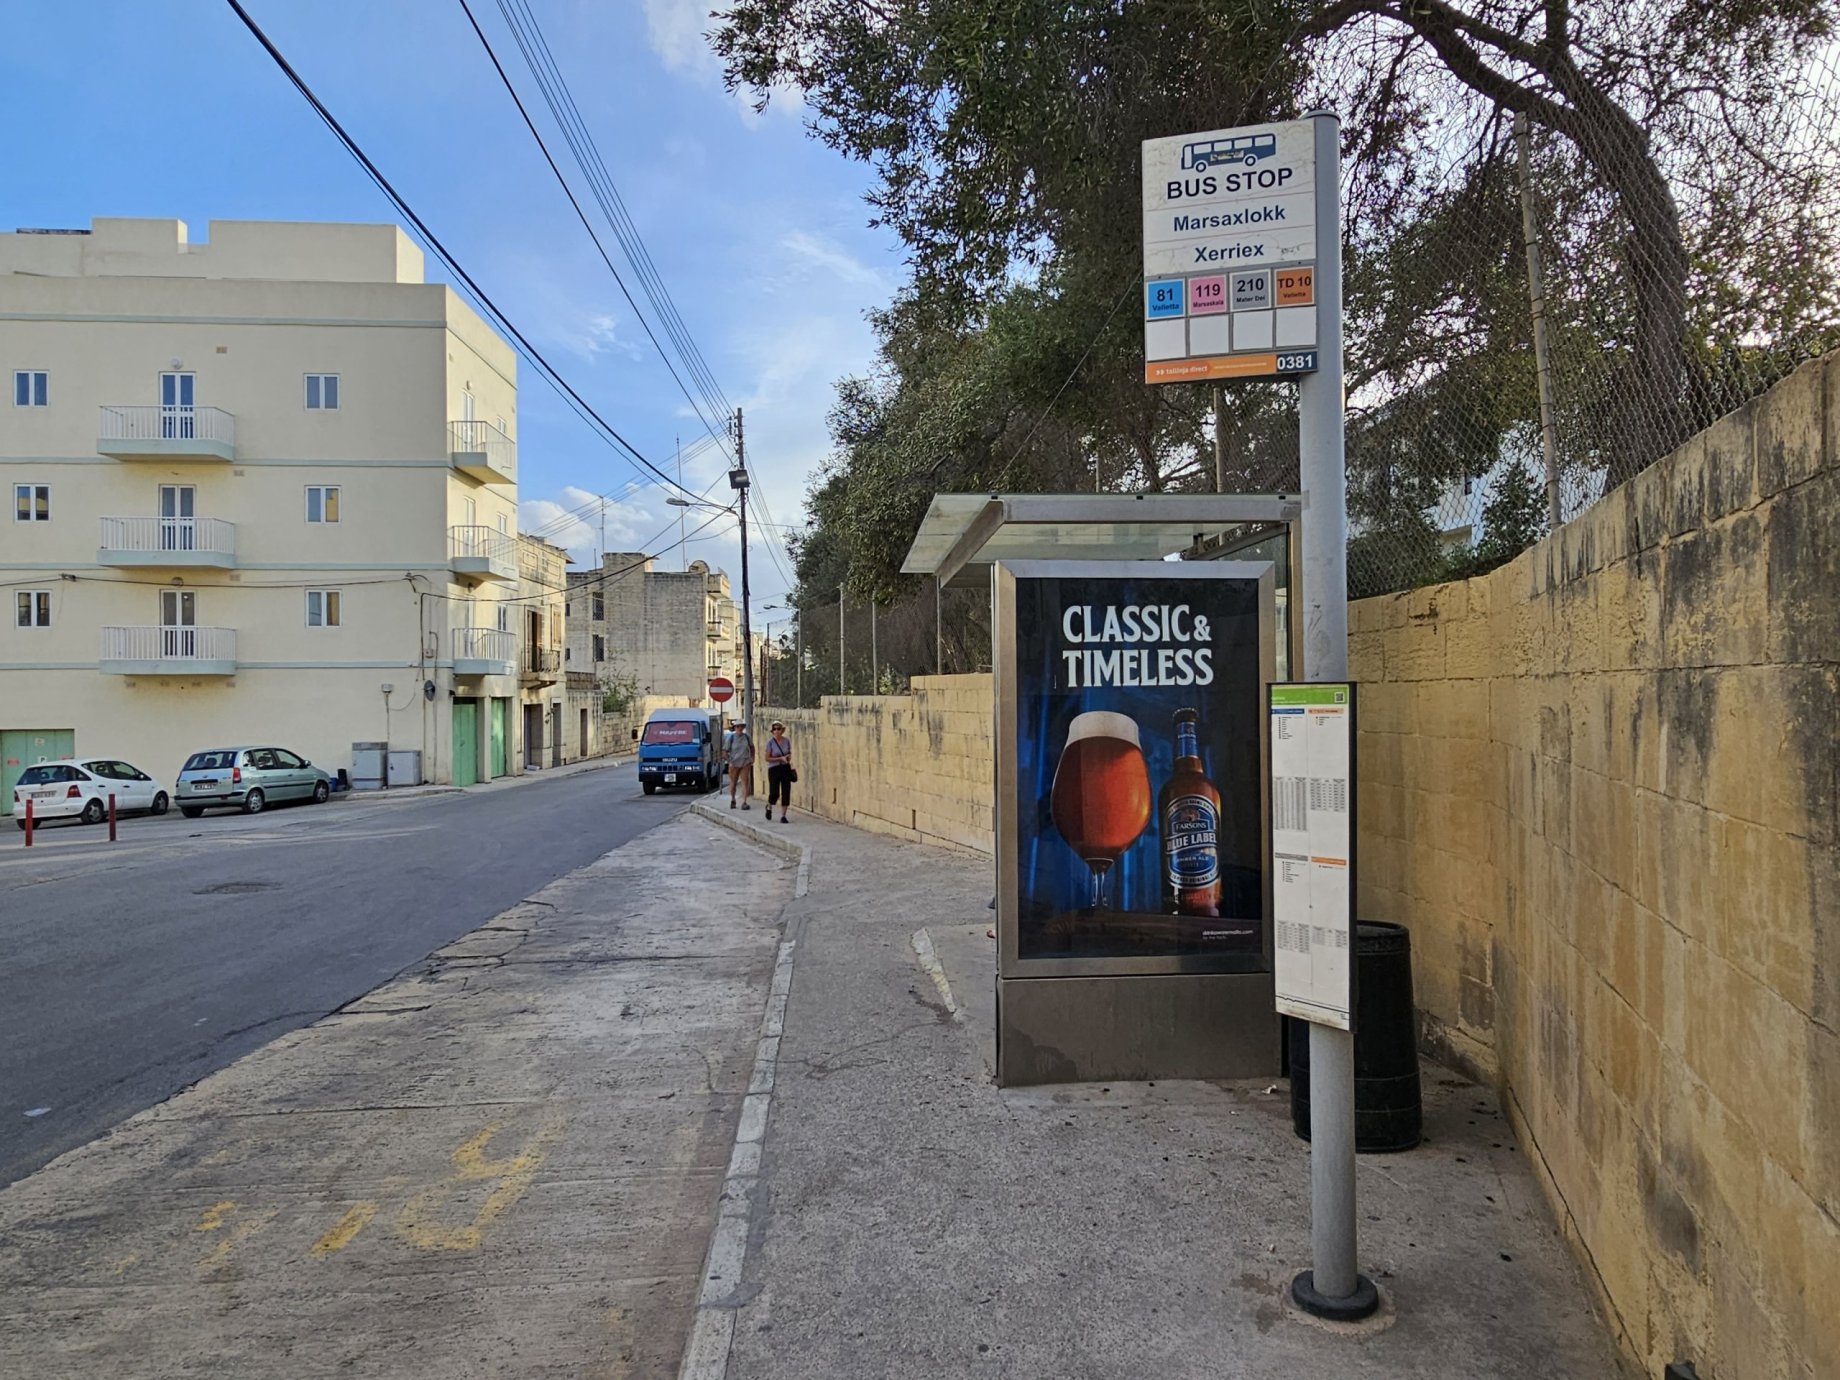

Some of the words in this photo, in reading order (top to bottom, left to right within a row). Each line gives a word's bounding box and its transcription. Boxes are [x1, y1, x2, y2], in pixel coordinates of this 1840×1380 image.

[1167, 176, 1217, 200] BUS
[1226, 167, 1293, 192] STOP
[1173, 205, 1286, 232] Marsaxlokk
[1194, 242, 1264, 263] Xerriex
[1195, 283, 1221, 298] 119
[1237, 278, 1264, 293] 210
[1277, 278, 1294, 289] TD
[1297, 276, 1312, 287] 10
[1156, 288, 1174, 301] 81
[1152, 303, 1180, 312] Valletta
[1276, 354, 1313, 370] 0381
[1062, 604, 1191, 643] CLASSIC
[1062, 648, 1214, 688] TIMELESS
[1175, 822, 1207, 831] FARSONS
[1166, 835, 1189, 851] BLUE
[1190, 832, 1217, 844] LABEL
